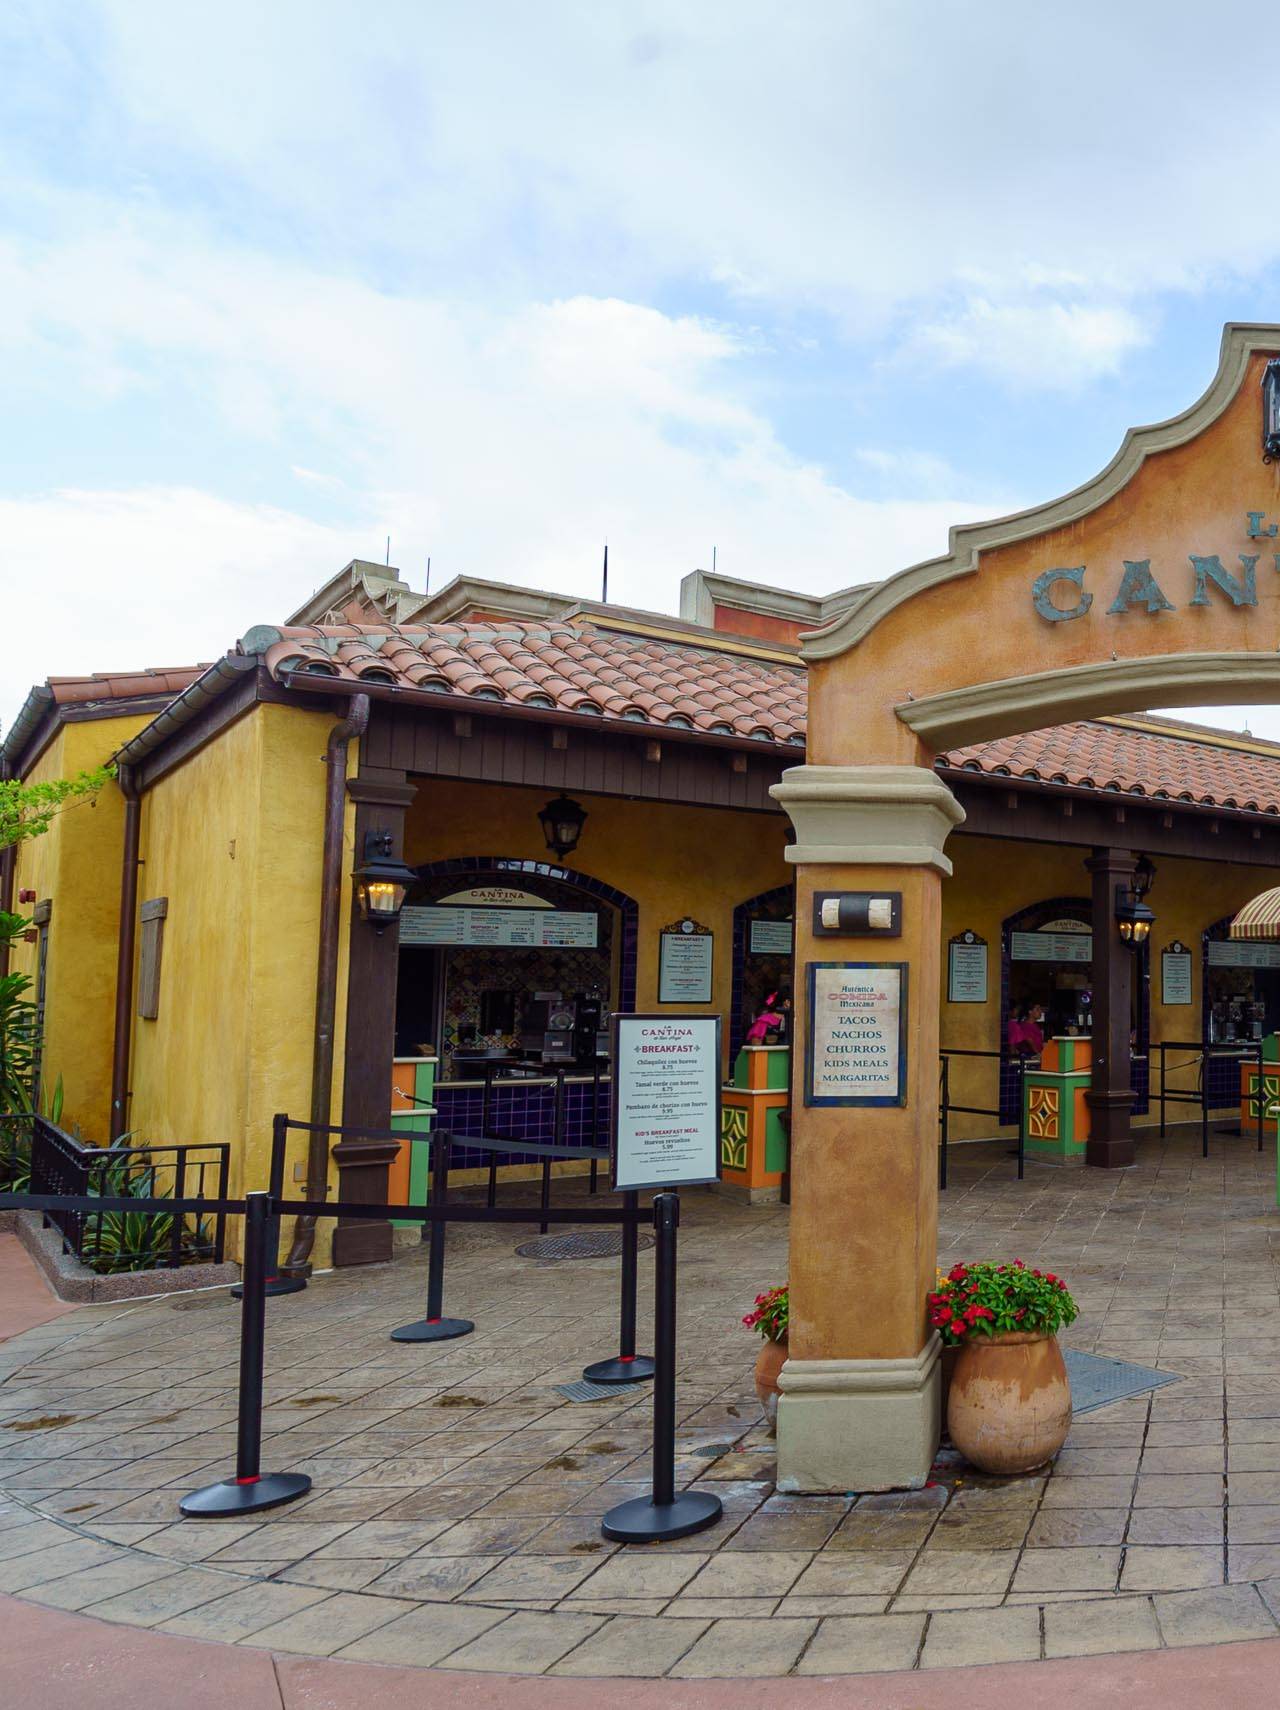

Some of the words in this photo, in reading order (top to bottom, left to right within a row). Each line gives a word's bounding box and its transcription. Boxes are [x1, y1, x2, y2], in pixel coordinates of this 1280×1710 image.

[470, 890, 525, 899] CANTINA
[838, 1016, 876, 1025] TACOS
[832, 1030, 882, 1039] NACHOS
[642, 1045, 694, 1053] BREAKFAST
[826, 1044, 886, 1054] CHURROS
